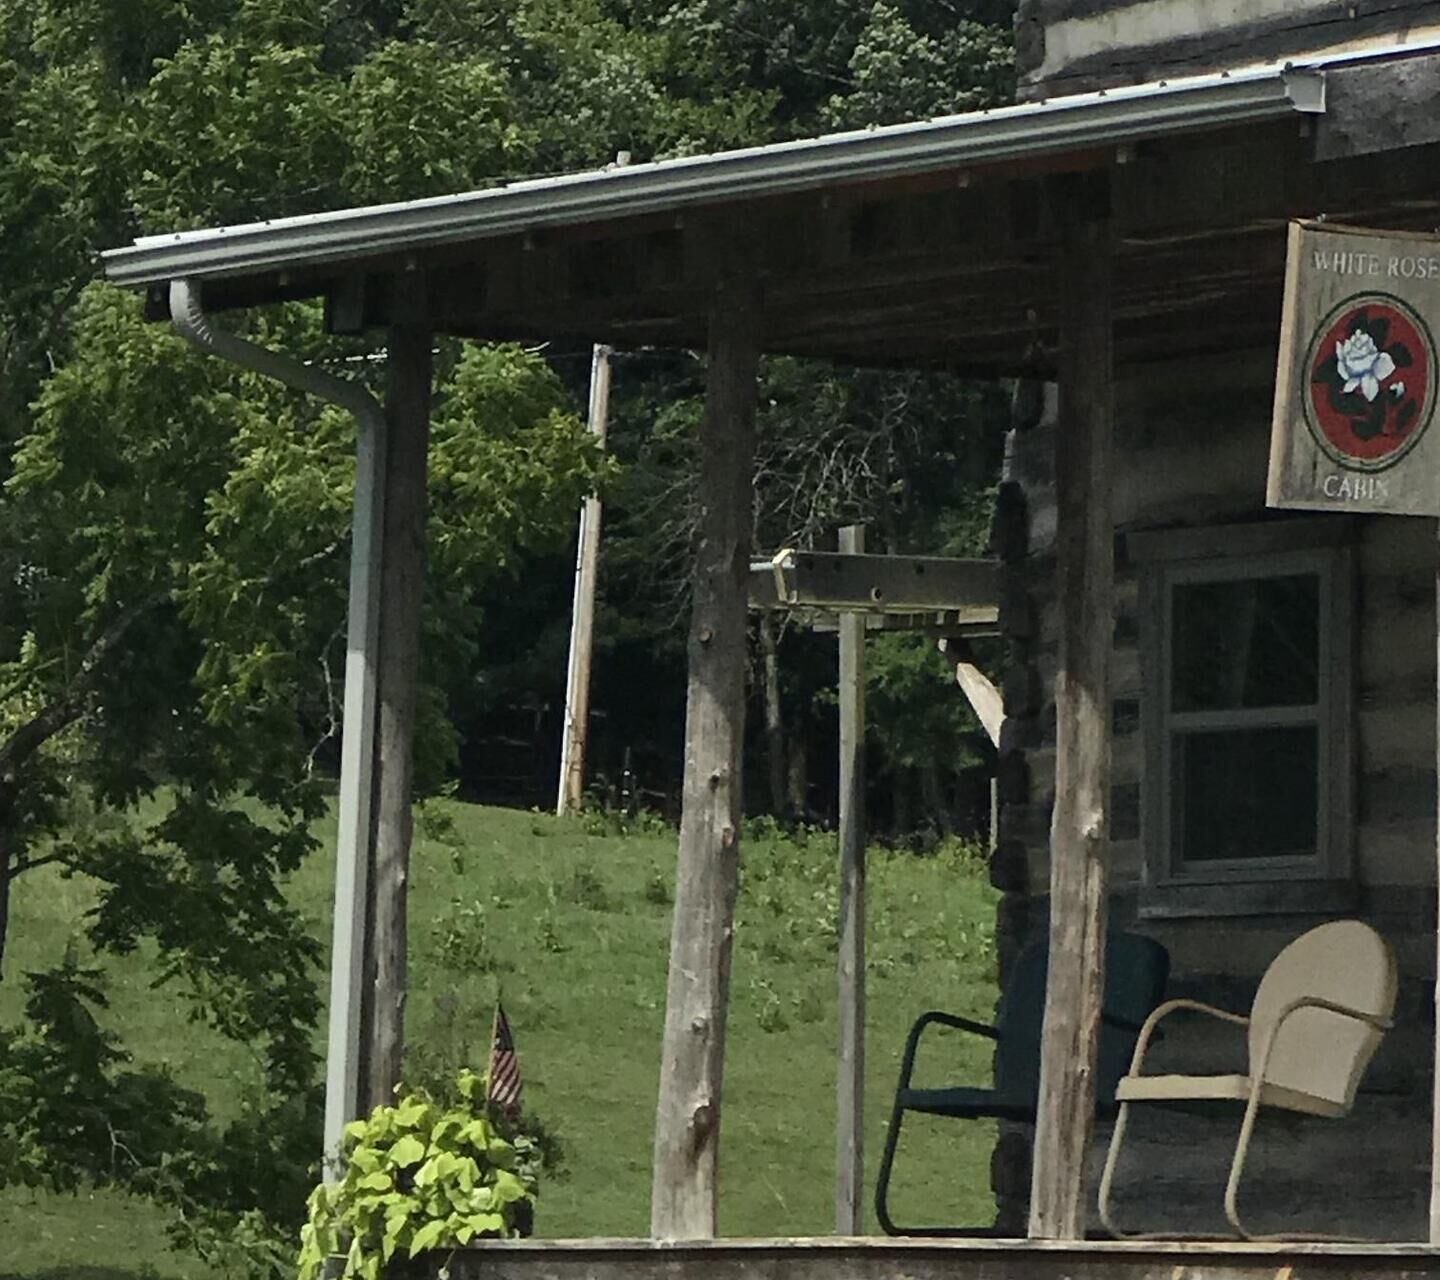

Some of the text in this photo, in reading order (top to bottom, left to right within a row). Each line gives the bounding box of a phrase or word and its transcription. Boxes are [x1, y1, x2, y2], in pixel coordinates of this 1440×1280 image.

[1313, 251, 1440, 279] WHITE ROSE
[1323, 475, 1390, 500] CABIN
